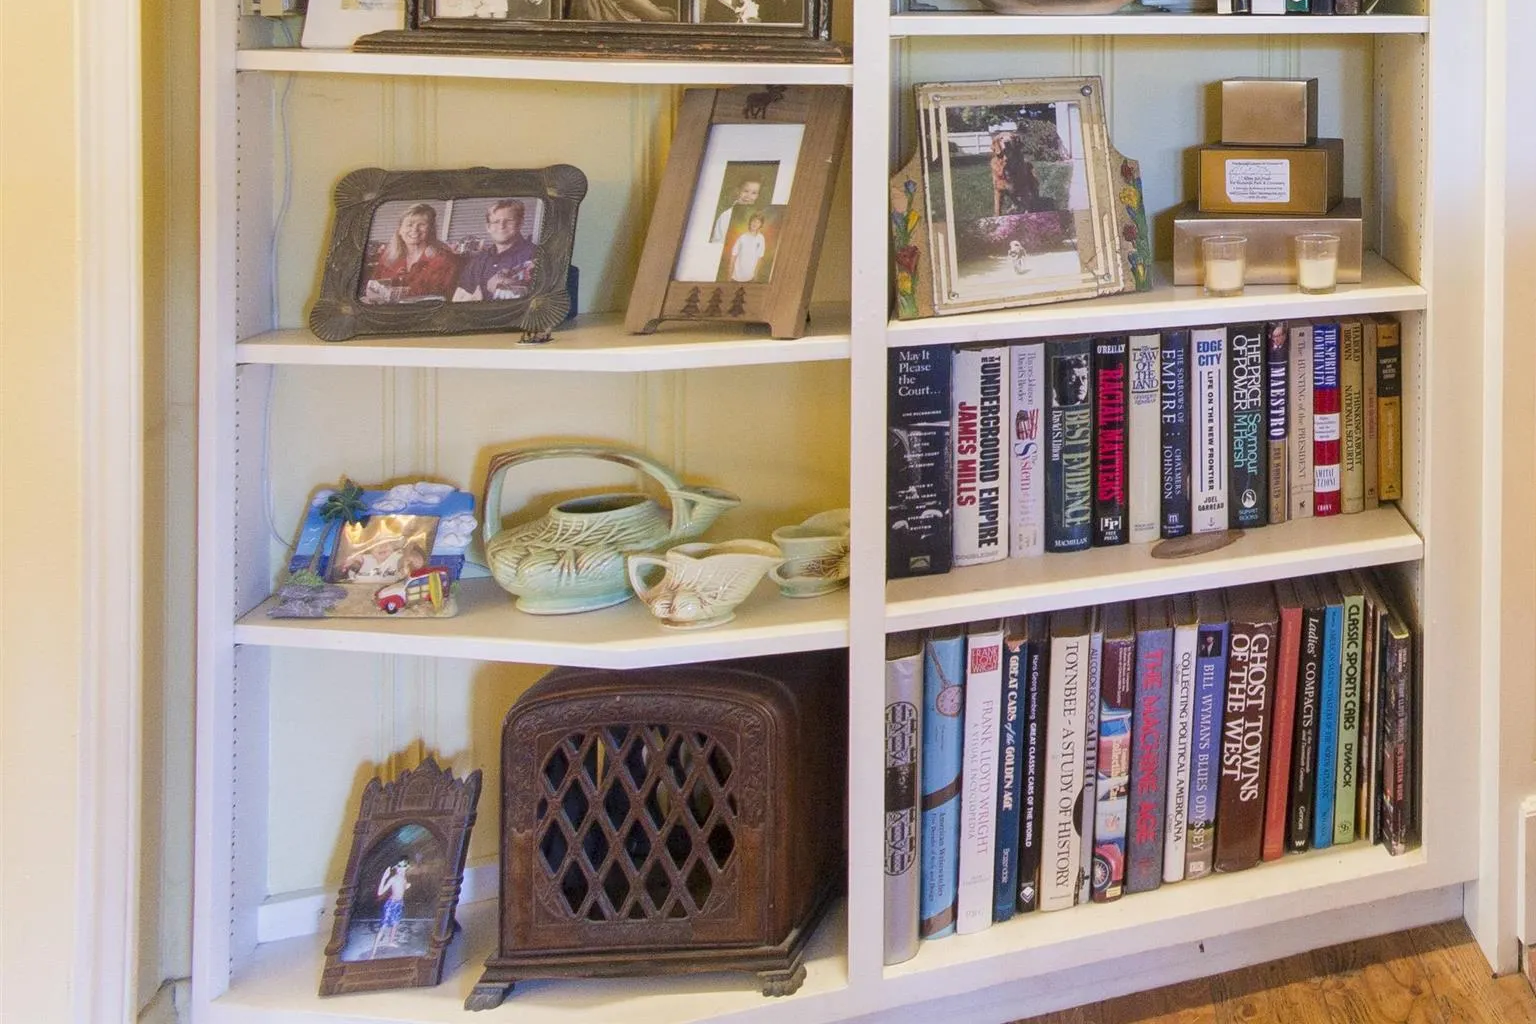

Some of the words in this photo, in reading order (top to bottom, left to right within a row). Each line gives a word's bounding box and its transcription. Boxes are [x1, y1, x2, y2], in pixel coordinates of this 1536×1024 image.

[1097, 343, 1125, 355] O'REILLY
[1196, 339, 1223, 354] EDGE
[1233, 335, 1247, 356] OF
[1247, 333, 1261, 364] THE
[1298, 342, 1306, 356] The
[1324, 329, 1336, 346] THE
[1344, 329, 1352, 361] BROWN
[1352, 326, 1361, 362] HAROLD
[899, 351, 921, 363] May
[922, 350, 930, 360] It
[899, 362, 932, 373] Please
[1132, 351, 1159, 361] LAW
[1136, 361, 1153, 371] OF
[1176, 348, 1184, 366] THE
[1197, 353, 1222, 367] CITY
[1313, 330, 1325, 386] COMMUNITY
[1324, 346, 1336, 375] SPIRIT
[898, 375, 917, 385] the
[898, 386, 941, 397] Court...
[1132, 378, 1159, 389] LAND
[1162, 349, 1176, 424] EMPIRE
[1233, 357, 1247, 411] POWER
[1247, 365, 1261, 409] PRICE
[1297, 359, 1306, 401] HUNTING
[1324, 375, 1336, 387] OF
[1207, 392, 1214, 404] ON
[1269, 367, 1286, 437] MAESTRO
[1298, 403, 1305, 411] of
[1345, 385, 1353, 429] NATIONAL
[957, 401, 977, 455] JAMES
[979, 362, 1001, 482] UNDERGROUND
[1052, 410, 1063, 431] David
[1065, 408, 1091, 447] BEST
[1177, 412, 1184, 423] OF
[1233, 415, 1247, 429] M.
[1298, 413, 1306, 425] the
[1233, 430, 1247, 468] Hersh
[1247, 413, 1261, 476] Seymour
[1346, 429, 1354, 472] SECURITY
[1354, 435, 1362, 465] ABOUT
[957, 459, 977, 507] MILLS
[1014, 442, 1038, 491] System
[1163, 445, 1173, 500] JOHNSON
[1174, 448, 1182, 495] CHALMERS
[1063, 452, 1091, 528] EVIDENCE
[1203, 496, 1218, 504] JOEL
[978, 488, 999, 548] EMPIRE
[1197, 503, 1224, 512] GARREAU
[1307, 617, 1319, 657] Ladies'
[1346, 604, 1360, 649] CLASSIC
[1031, 655, 1039, 671] Hans
[1231, 633, 1250, 662] OF
[1008, 655, 1020, 690] GREAT
[1030, 672, 1039, 692] Georg
[1063, 642, 1079, 717] TOYNBEE
[1089, 660, 1098, 687] COLOR
[1143, 648, 1164, 689] THE
[1179, 652, 1191, 719] COLLECTING
[1202, 664, 1215, 690] BILL
[1246, 633, 1270, 711] GHOST
[1345, 652, 1358, 698] SPORTS
[1088, 688, 1097, 713] BOOK
[1226, 665, 1247, 713] THE
[1302, 662, 1316, 728] COMPACTS
[981, 699, 994, 743] FRANK
[1005, 691, 1017, 722] CARS
[1088, 714, 1096, 725] OF
[1198, 694, 1213, 750] WYMAN'S
[1343, 700, 1356, 731] CARS
[970, 732, 979, 764] VISUAL
[1029, 723, 1037, 746] GREAT
[1062, 727, 1074, 739] A
[1137, 696, 1161, 795] MACHINE
[1176, 721, 1187, 777] POLITICAL
[1222, 716, 1244, 781] WEST
[979, 750, 992, 794] LLOYD
[1003, 746, 1015, 789] GOLDEN
[1028, 746, 1036, 775] CLASSIC
[1059, 739, 1075, 794] STUDY
[1197, 754, 1209, 792] BLUES
[1239, 715, 1264, 802] TOWNS
[1343, 743, 1354, 788] DYMOCK
[1003, 791, 1014, 812] AGE
[1027, 776, 1035, 796] CARS
[1027, 797, 1034, 806] OF
[968, 768, 978, 840] ENCYCLOPEDIA
[1026, 807, 1034, 821] THE
[1059, 797, 1071, 818] OF
[1173, 778, 1185, 842] AMERICANA
[938, 812, 946, 846] American
[977, 795, 989, 855] WRIGHT
[1025, 821, 1033, 847] WORLD
[1136, 801, 1157, 845] AGE
[1192, 795, 1207, 851] ODYSSEY
[1055, 822, 1072, 888] HISTORY
